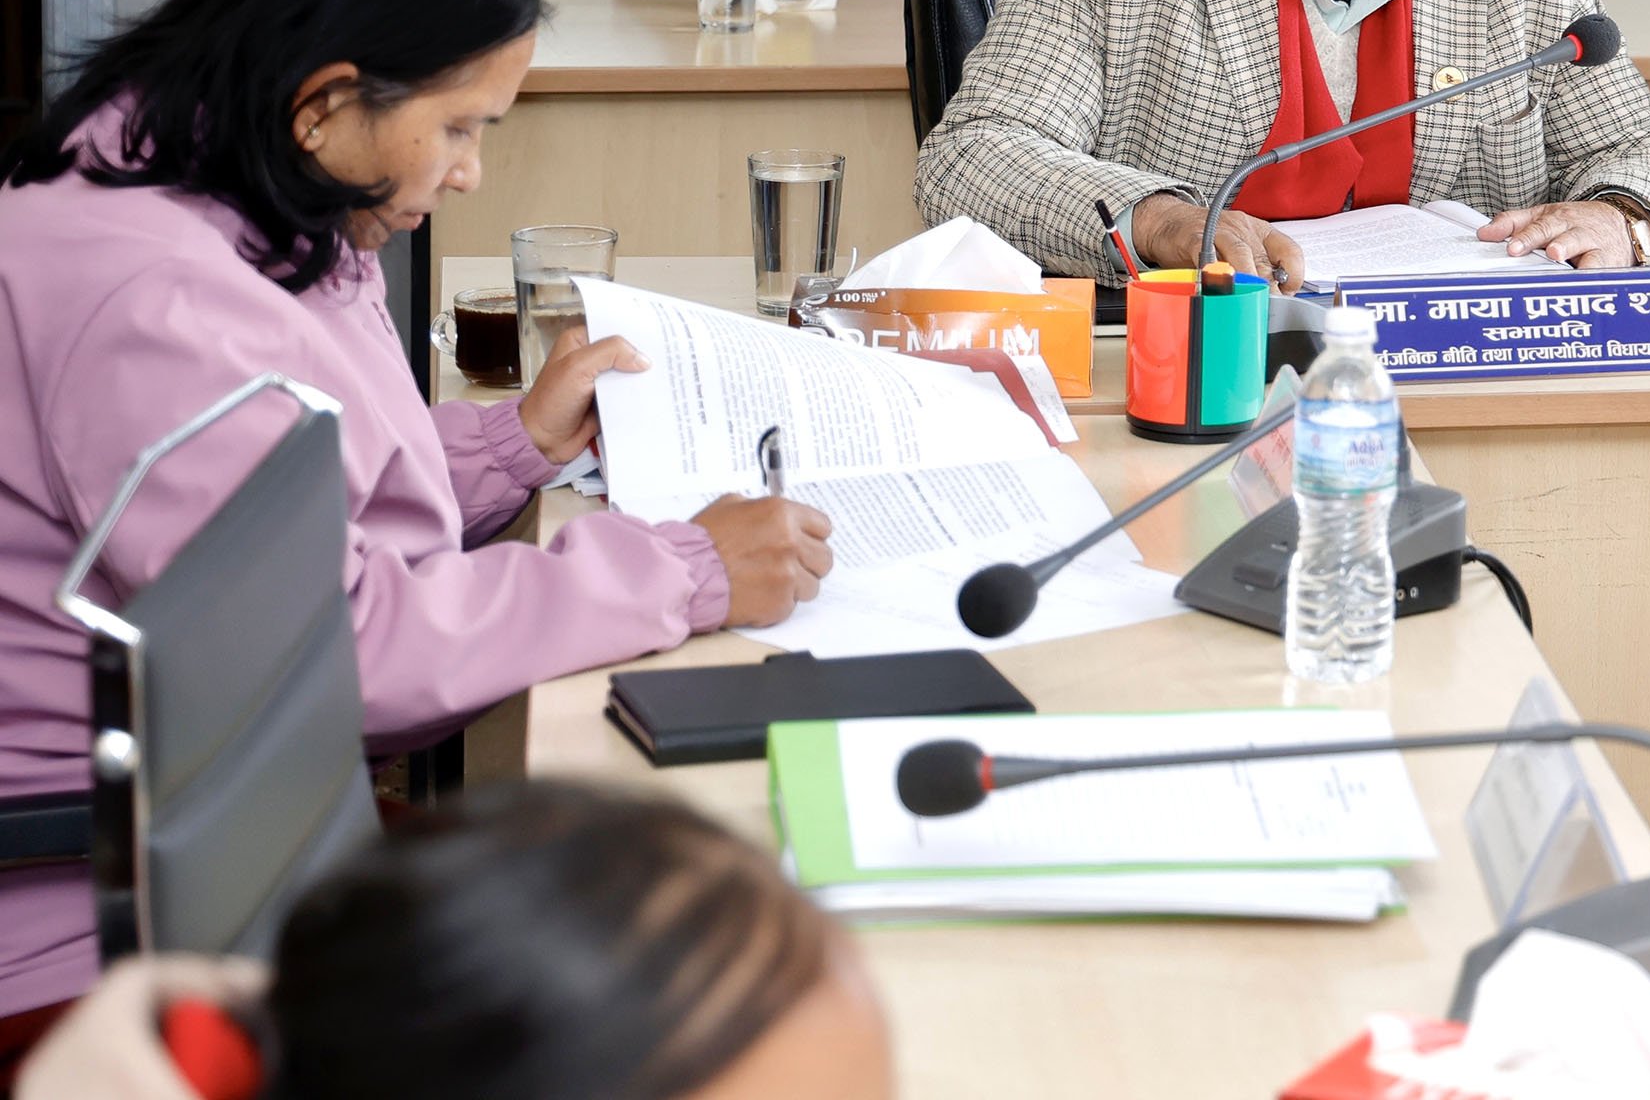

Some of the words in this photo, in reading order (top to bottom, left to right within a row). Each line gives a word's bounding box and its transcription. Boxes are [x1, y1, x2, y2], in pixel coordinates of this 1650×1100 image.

[834, 292, 861, 303] 100
[1365, 301, 1416, 322] मा.
[1427, 296, 1512, 321] माया
[1523, 292, 1618, 321] प्रसाद
[1482, 320, 1592, 342] सभापति
[1441, 344, 1478, 364] नीति
[1482, 348, 1512, 363] तथा
[1518, 342, 1602, 364] प्रत्यायोजित
